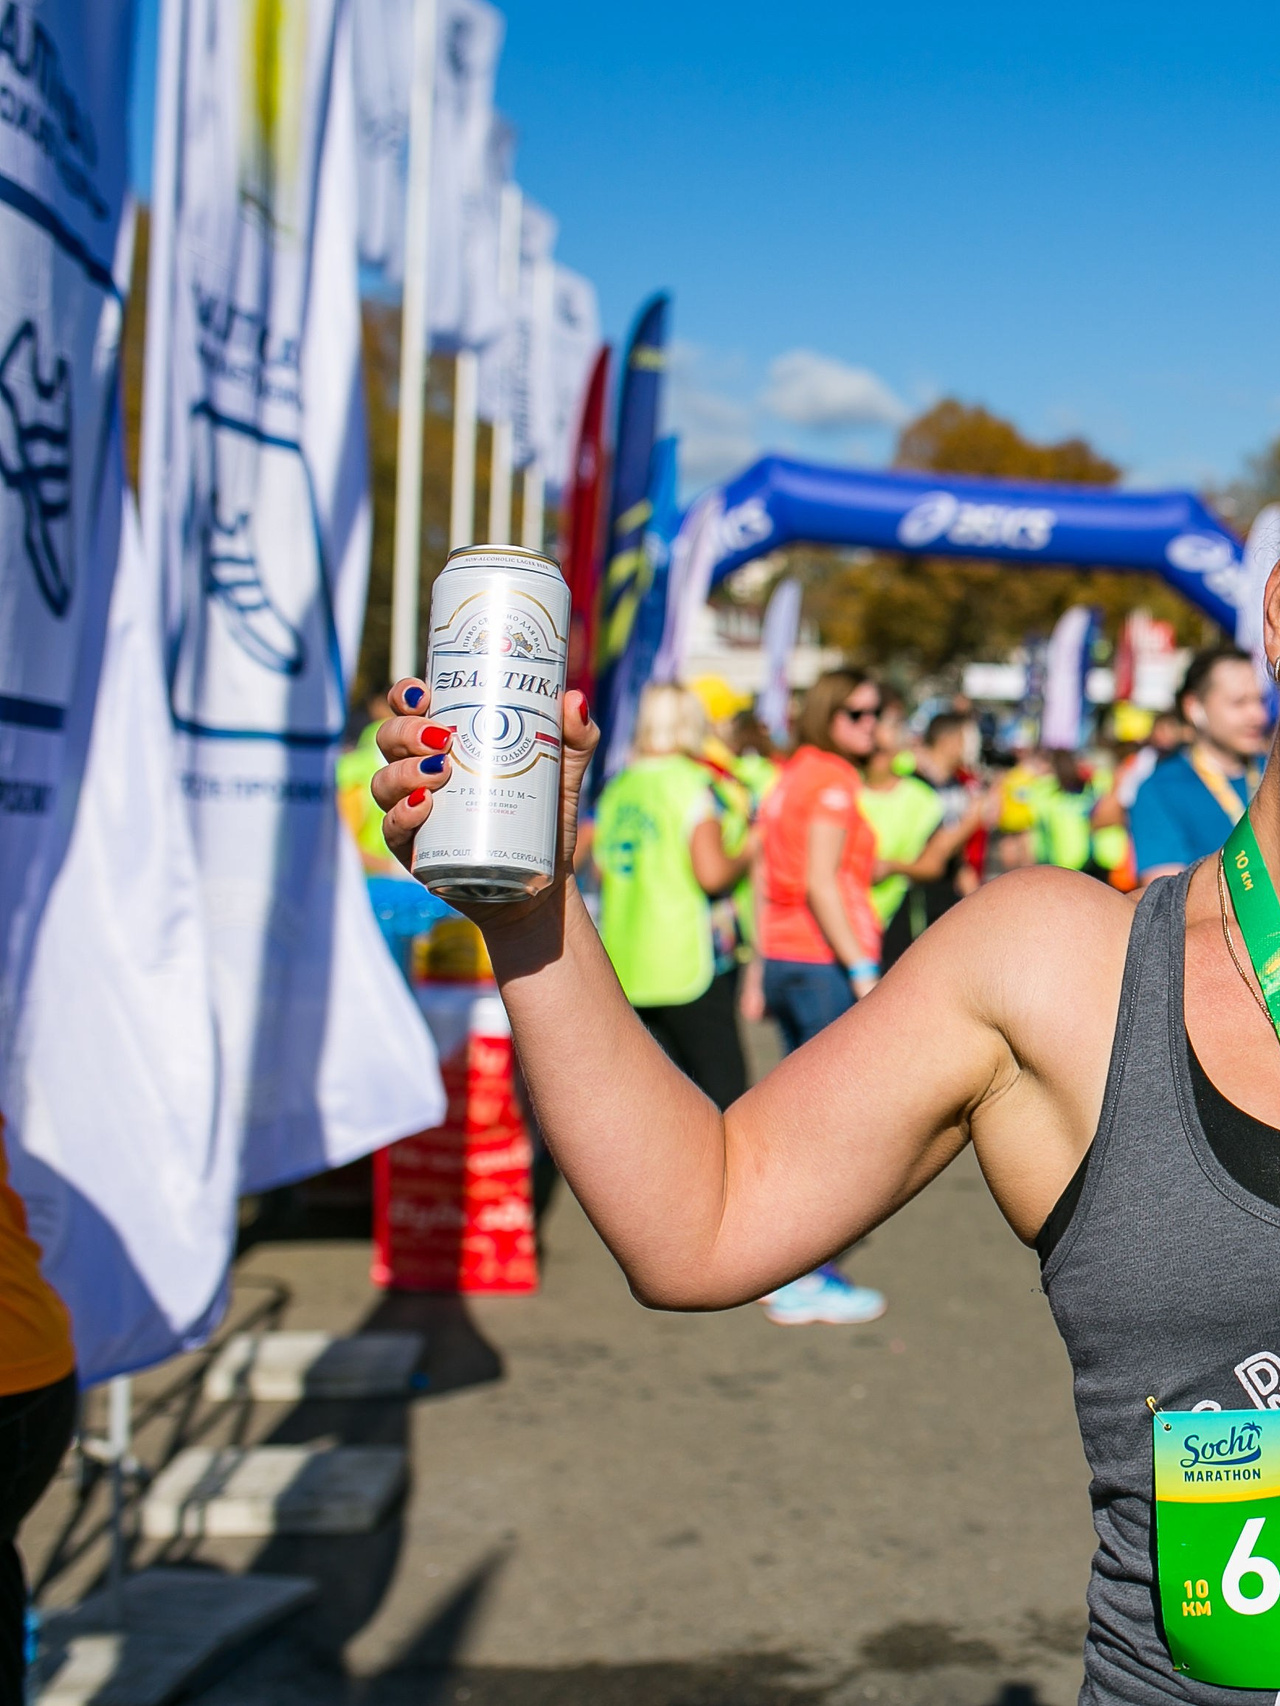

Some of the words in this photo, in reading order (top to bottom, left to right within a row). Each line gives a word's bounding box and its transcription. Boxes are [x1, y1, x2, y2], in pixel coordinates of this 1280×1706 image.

[449, 669, 562, 700] БАТИКА
[460, 732, 533, 763] БЕЗАЛОГОЛЬНОЕ
[459, 787, 526, 800] PRMIUM
[465, 800, 498, 808] СВЕОЕ
[1235, 850, 1249, 869] 10
[1241, 871, 1254, 891] KM
[1180, 1421, 1263, 1468] Sochi
[1184, 1468, 1262, 1483] MARATHON
[1184, 1579, 1209, 1599] 10
[1182, 1601, 1212, 1617] KM
